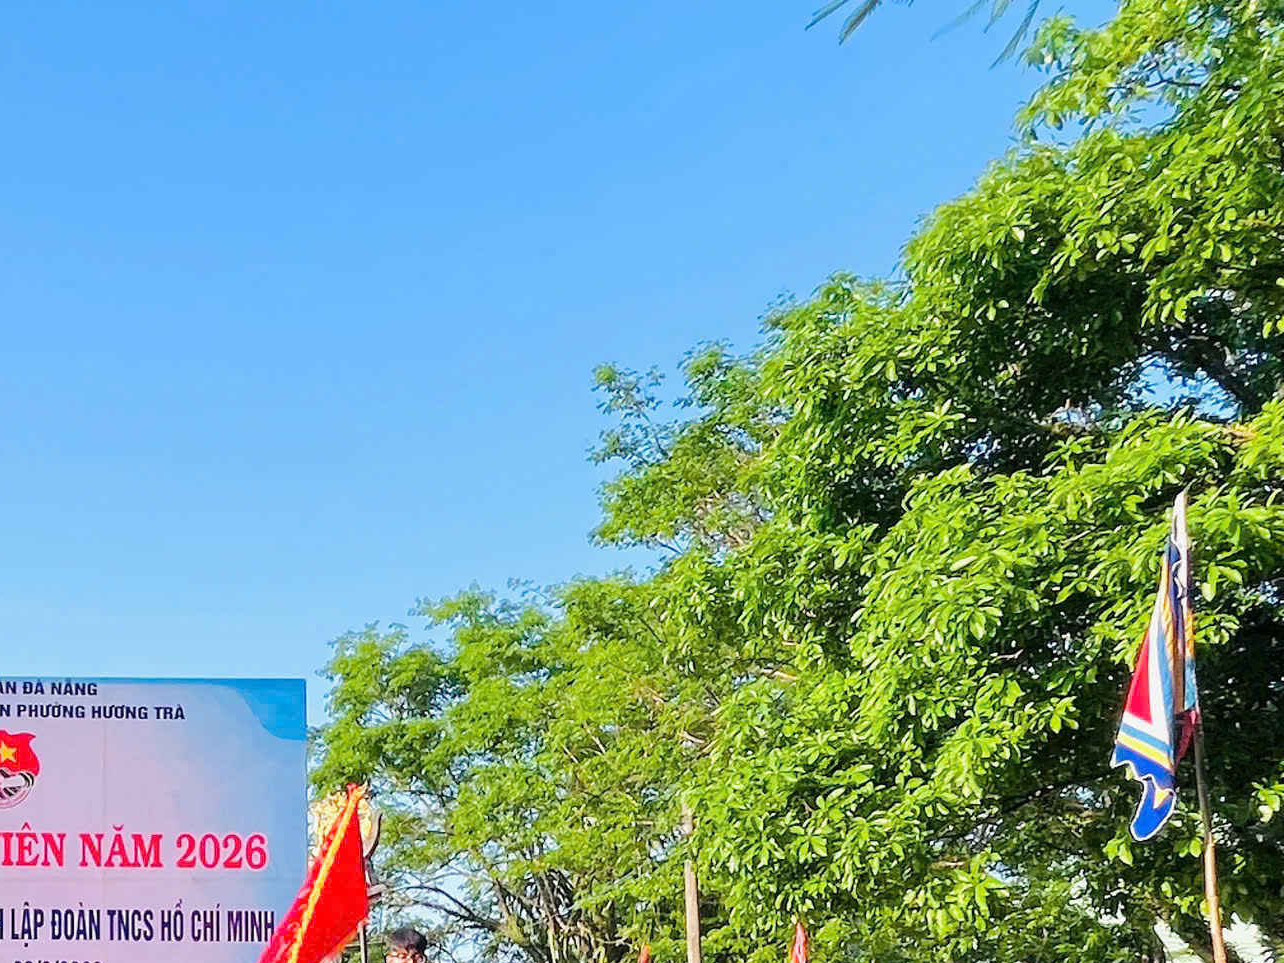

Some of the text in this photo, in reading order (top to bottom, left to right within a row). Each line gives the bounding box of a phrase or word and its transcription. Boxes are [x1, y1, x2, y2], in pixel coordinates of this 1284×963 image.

[23, 679, 45, 695] ĐÀ
[17, 701, 85, 719] PHƯỜNG
[92, 704, 148, 720] HƯƠNG
[154, 704, 186, 720] TRÀ
[79, 824, 164, 869] NĂM
[176, 833, 267, 870] 2026
[11, 902, 45, 948] LẬP
[51, 902, 101, 941] ĐOÀN
[107, 909, 154, 942] TNCS
[161, 899, 184, 942] HỒ
[191, 903, 221, 942] CHÍ
[227, 910, 275, 942] MINH
